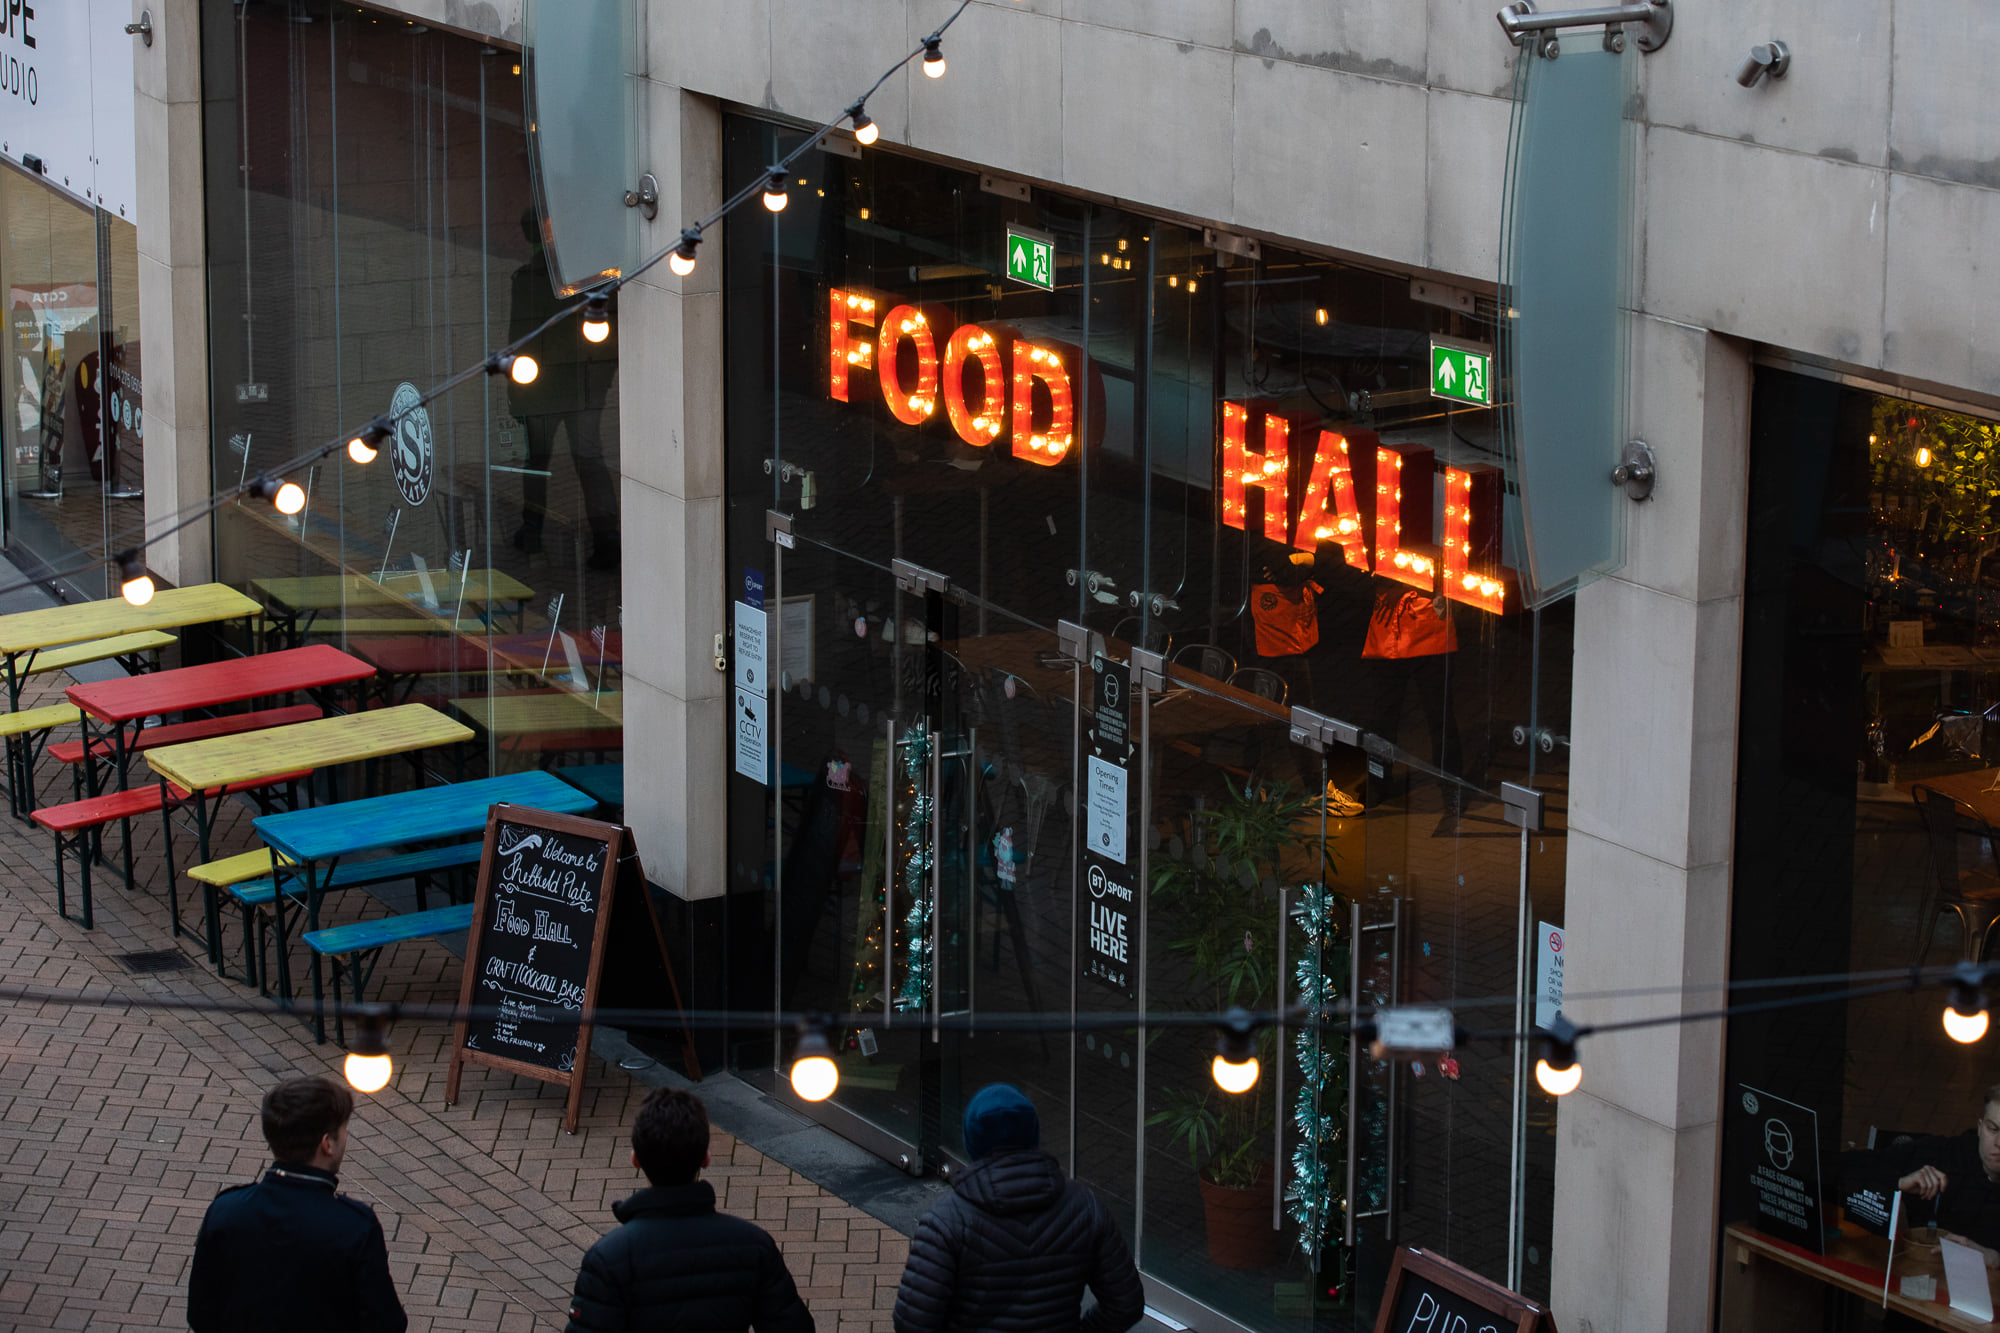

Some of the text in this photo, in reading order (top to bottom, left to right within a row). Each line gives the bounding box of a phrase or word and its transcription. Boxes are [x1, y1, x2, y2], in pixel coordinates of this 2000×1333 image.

[830, 287, 1074, 467] FOOD
[397, 467, 427, 501] PLATE
[1222, 400, 1505, 616] HALL
[739, 720, 762, 740] CCTV
[1095, 766, 1119, 785] Opening
[1098, 778, 1115, 794] Times
[542, 836, 599, 873] Welcome to
[502, 852, 593, 902] Sheffield Plate
[1092, 874, 1132, 902] BT SPORT
[1090, 900, 1128, 941] LIVE
[1090, 926, 1128, 964] HERE
[1554, 955, 1564, 968] N
[503, 994, 516, 1007] Live
